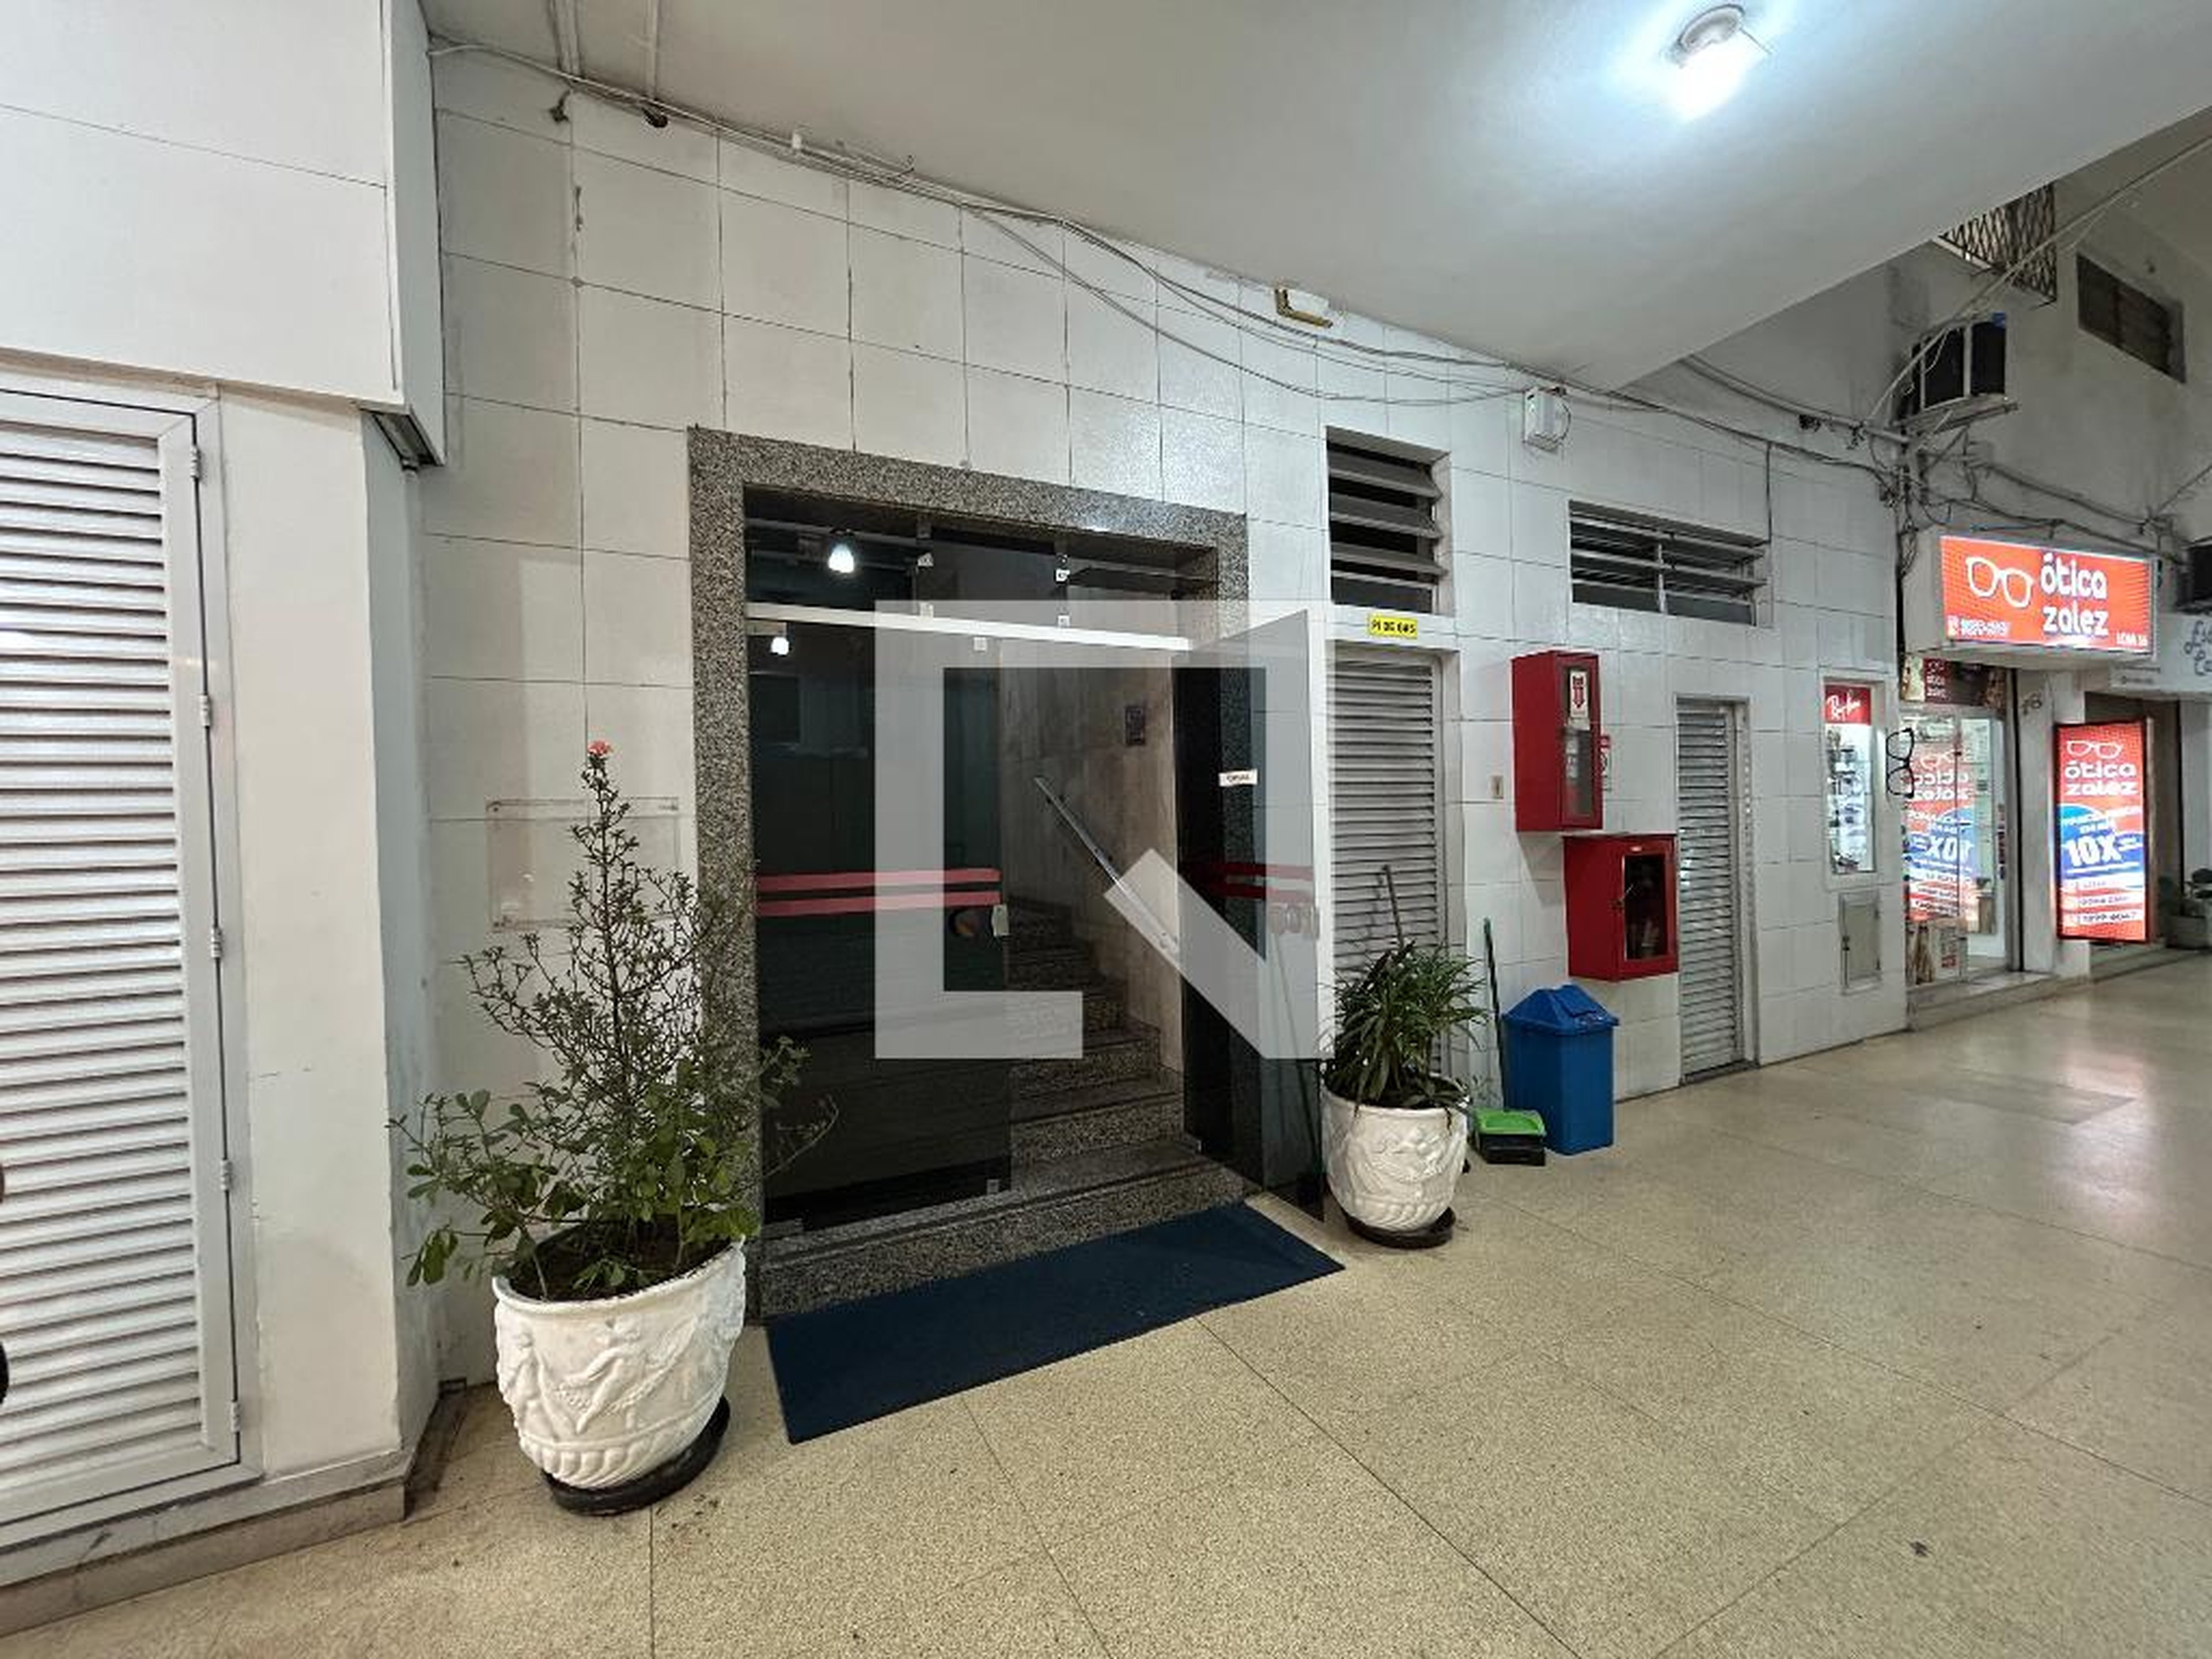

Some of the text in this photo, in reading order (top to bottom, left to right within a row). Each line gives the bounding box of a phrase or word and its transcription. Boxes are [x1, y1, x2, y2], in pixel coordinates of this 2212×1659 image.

[2041, 552, 2108, 600] ótica
[2043, 605, 2109, 637] zalez
[2064, 760, 2137, 778] ótica
[2065, 780, 2138, 796] zalez
[2067, 833, 2123, 866] 10X
